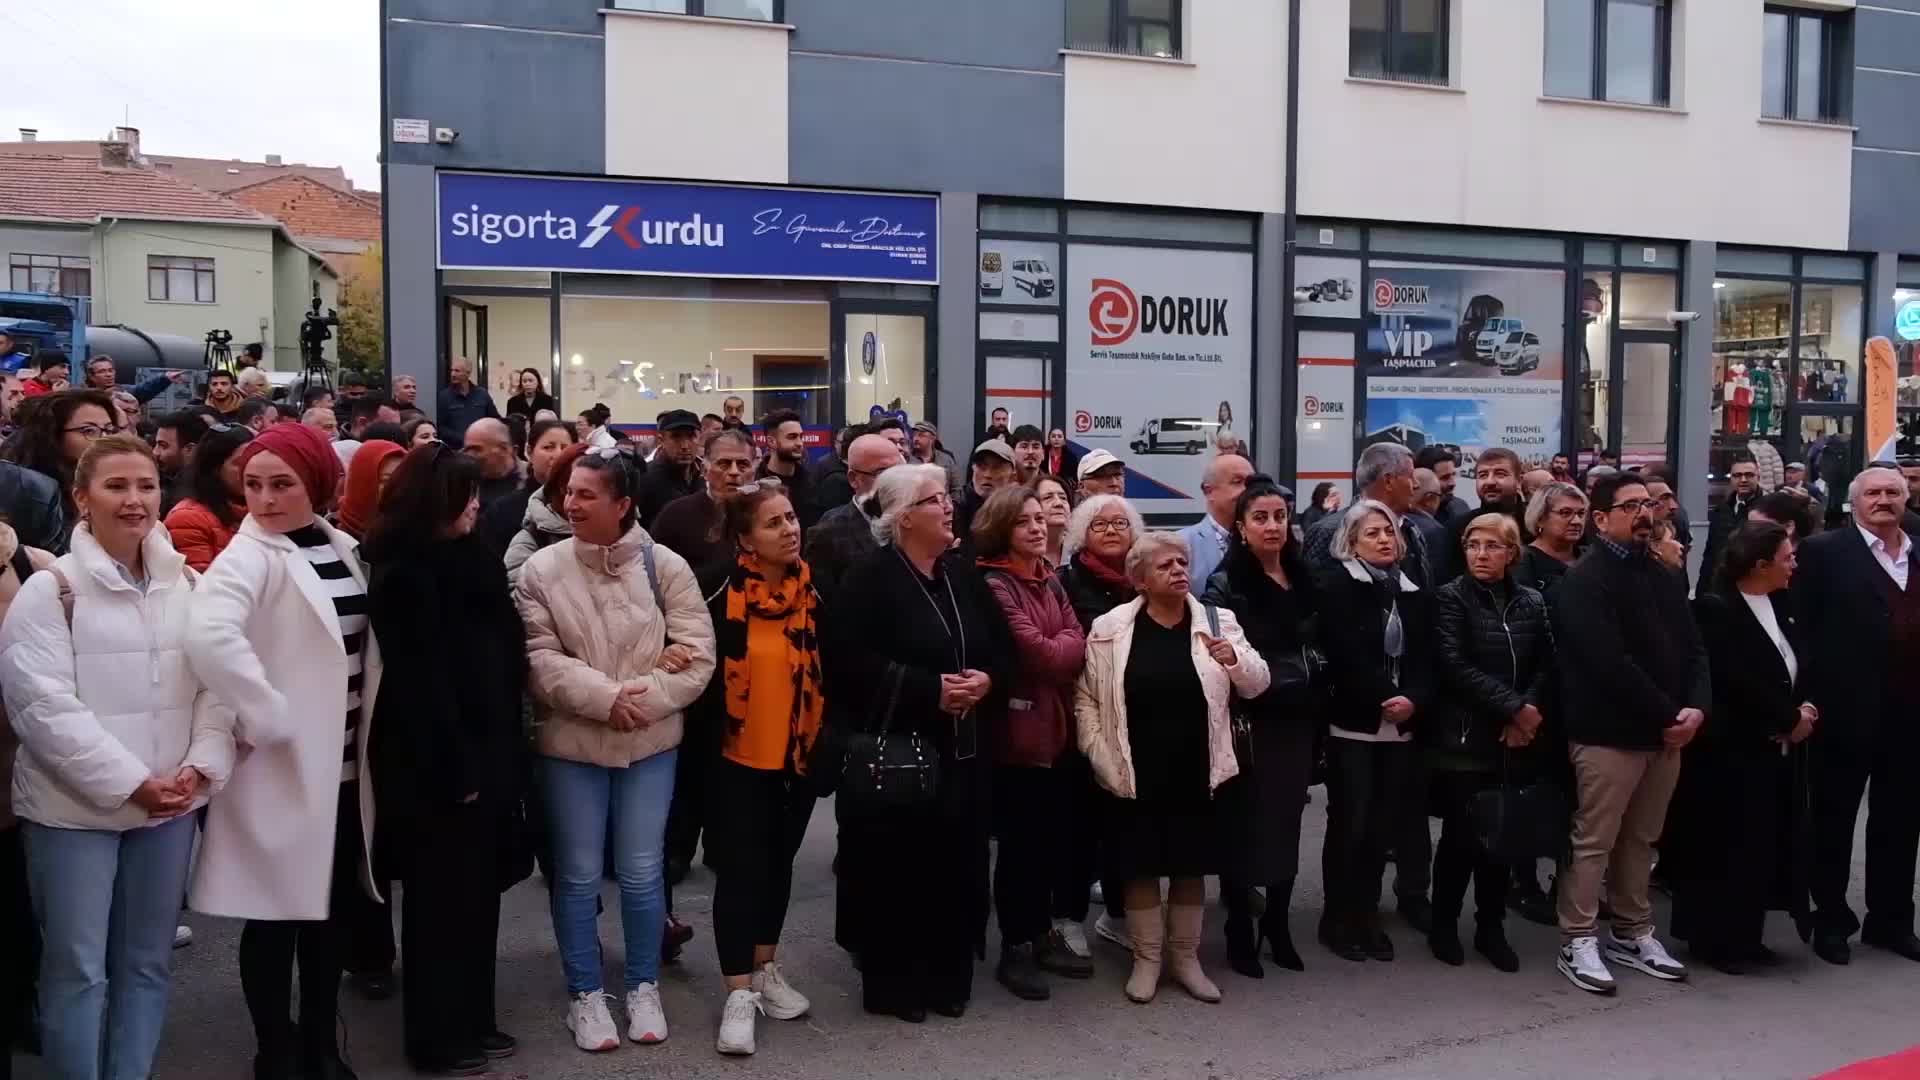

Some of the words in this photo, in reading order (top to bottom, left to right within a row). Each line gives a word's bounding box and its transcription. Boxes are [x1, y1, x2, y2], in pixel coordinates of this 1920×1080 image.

[451, 204, 577, 244] sigorta
[1393, 286, 1428, 303] DORUK
[1140, 295, 1229, 337] DORUK
[1384, 323, 1433, 357] VİP
[1320, 401, 1345, 413] DORUK
[1093, 415, 1122, 429] DORUK
